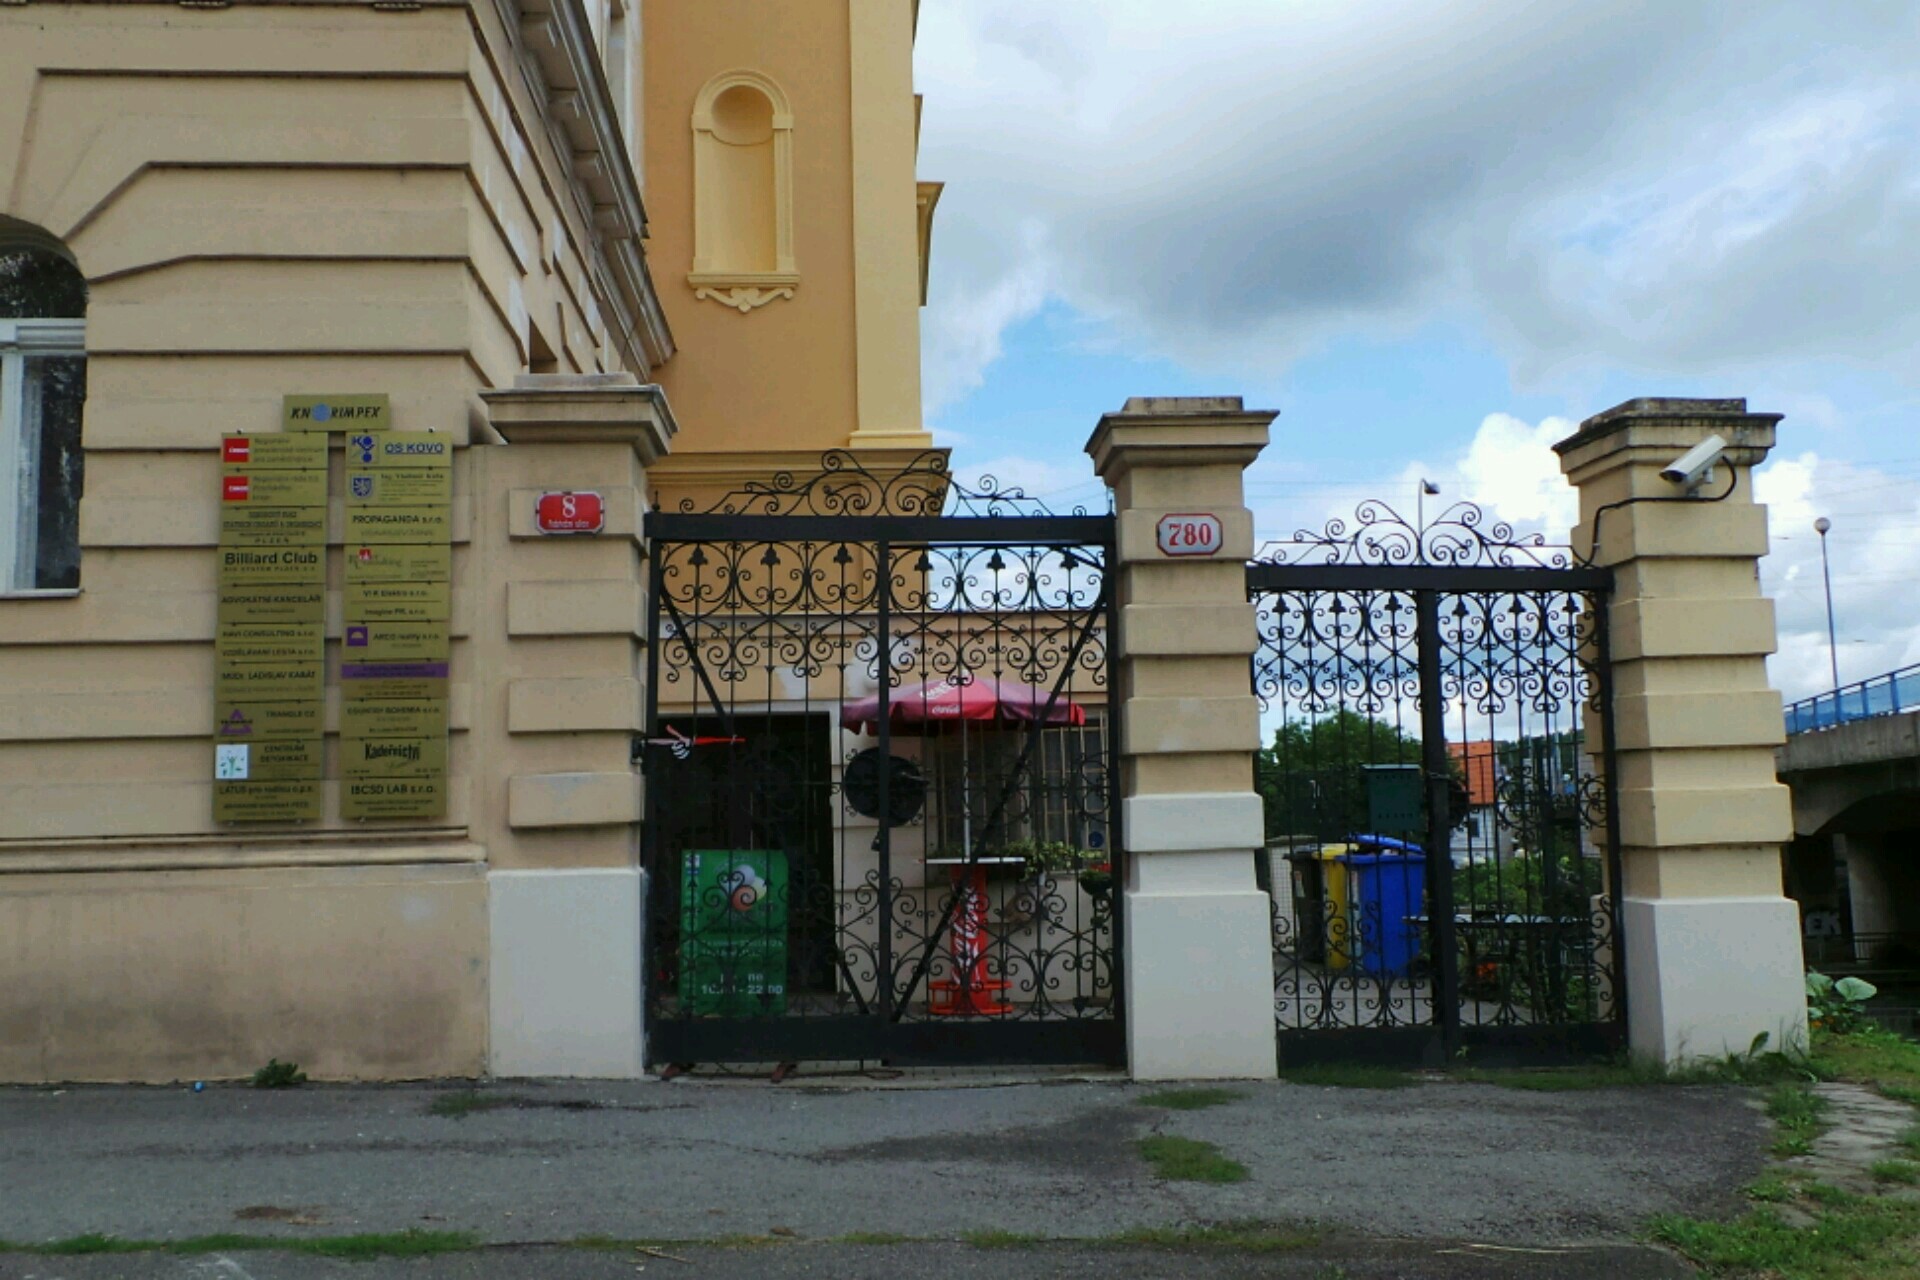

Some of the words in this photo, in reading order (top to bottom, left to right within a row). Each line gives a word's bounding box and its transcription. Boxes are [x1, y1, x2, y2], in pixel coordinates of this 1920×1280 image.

[385, 443, 404, 454] OS
[406, 442, 445, 454] KOVO
[562, 495, 576, 518] 8
[353, 514, 419, 524] PROPAGANDA
[1168, 522, 1212, 546] 780
[225, 552, 278, 565] Billiard
[282, 551, 318, 564] Club
[387, 783, 408, 793] LAB
